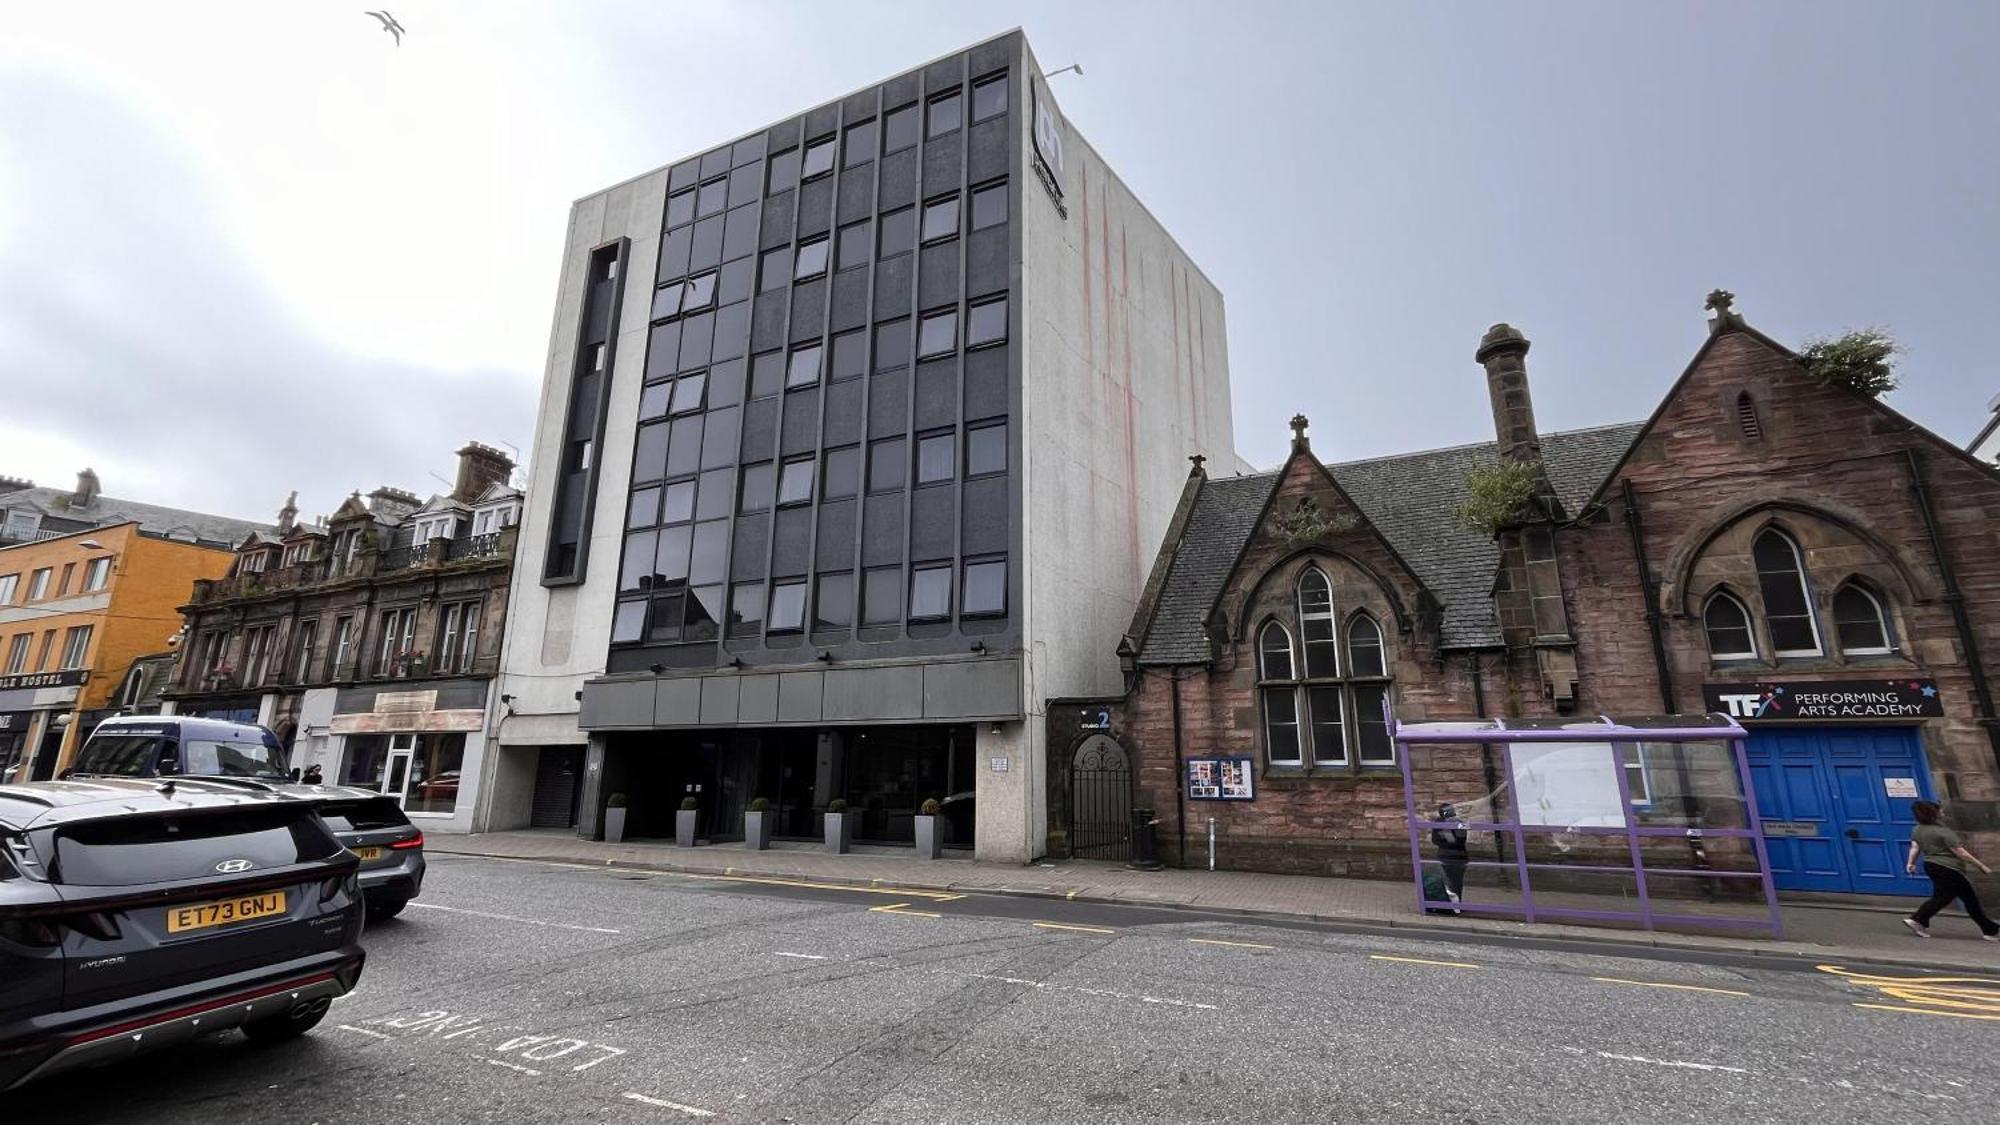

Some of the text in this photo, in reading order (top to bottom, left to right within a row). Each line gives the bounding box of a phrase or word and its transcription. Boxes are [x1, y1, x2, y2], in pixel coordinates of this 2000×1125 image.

[20, 674, 62, 687] HOSTEL
[1794, 692, 1899, 704] PERFORMING
[1798, 704, 1923, 716] ARTS ACADEMY
[1098, 711, 1110, 729] 2
[177, 898, 277, 928] ET73 GNJ
